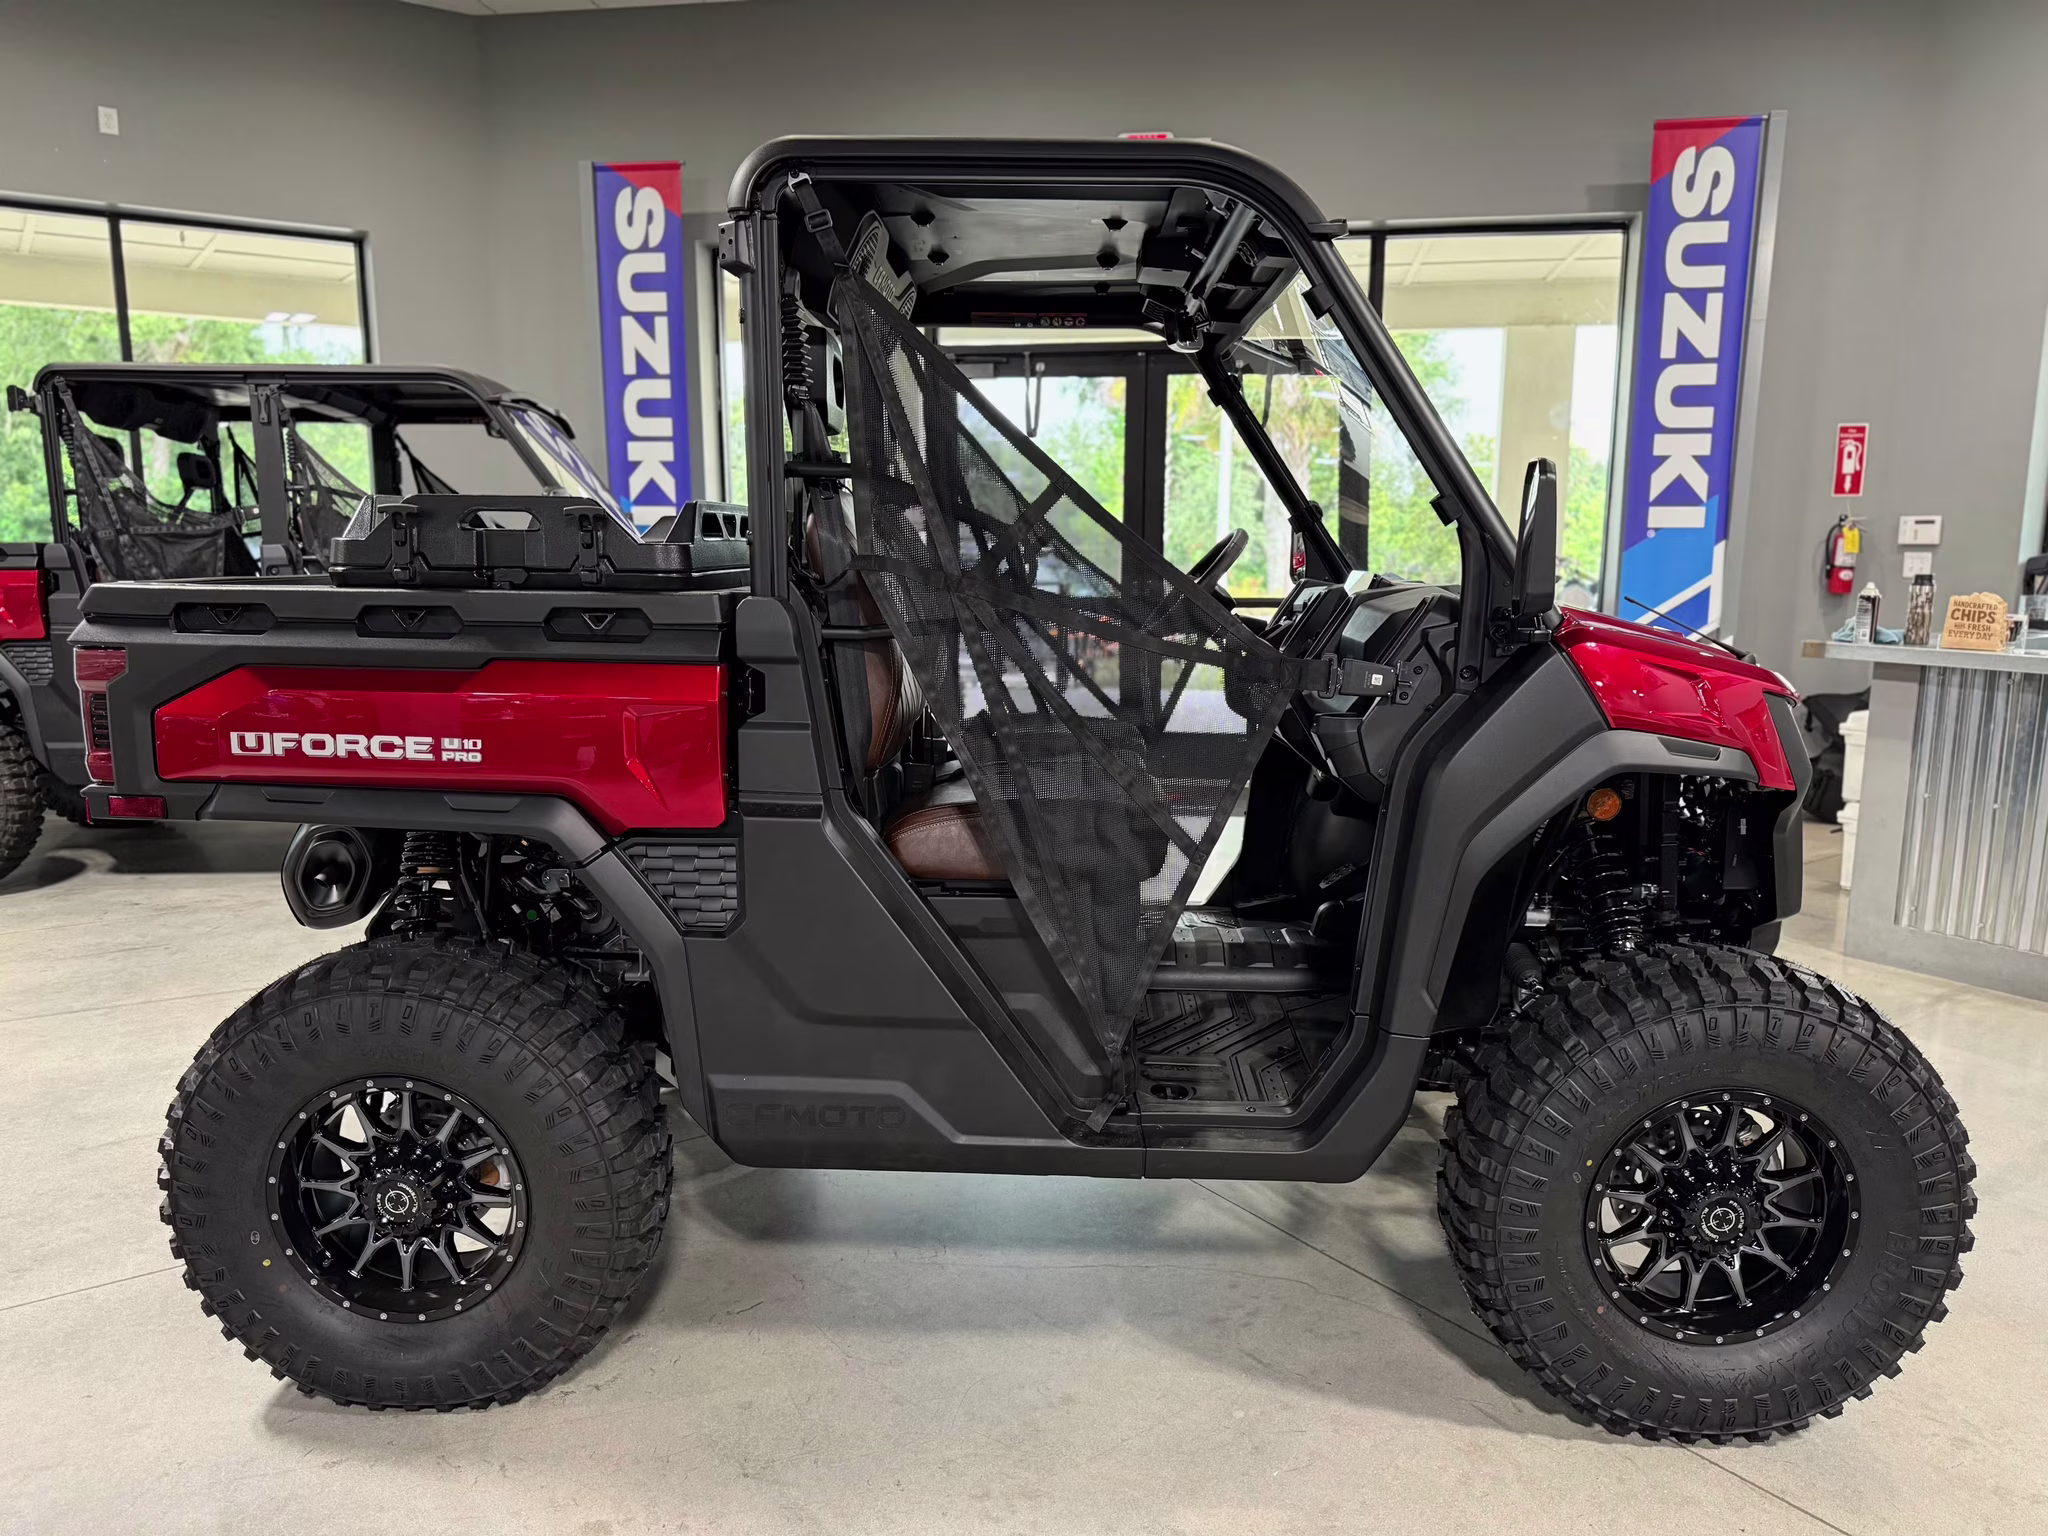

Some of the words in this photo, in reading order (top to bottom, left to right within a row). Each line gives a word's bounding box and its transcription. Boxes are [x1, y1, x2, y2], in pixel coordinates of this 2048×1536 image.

[1647, 146, 1735, 528] SUZUKI
[614, 187, 677, 526] SUZUKI
[1953, 600, 1998, 611] HANDCRAFTED
[1950, 608, 1997, 624] CHIPS
[1967, 623, 1991, 632] FRESH
[441, 737, 482, 750] U10
[441, 751, 482, 762] PRO
[726, 1103, 906, 1130] CFMOTO
